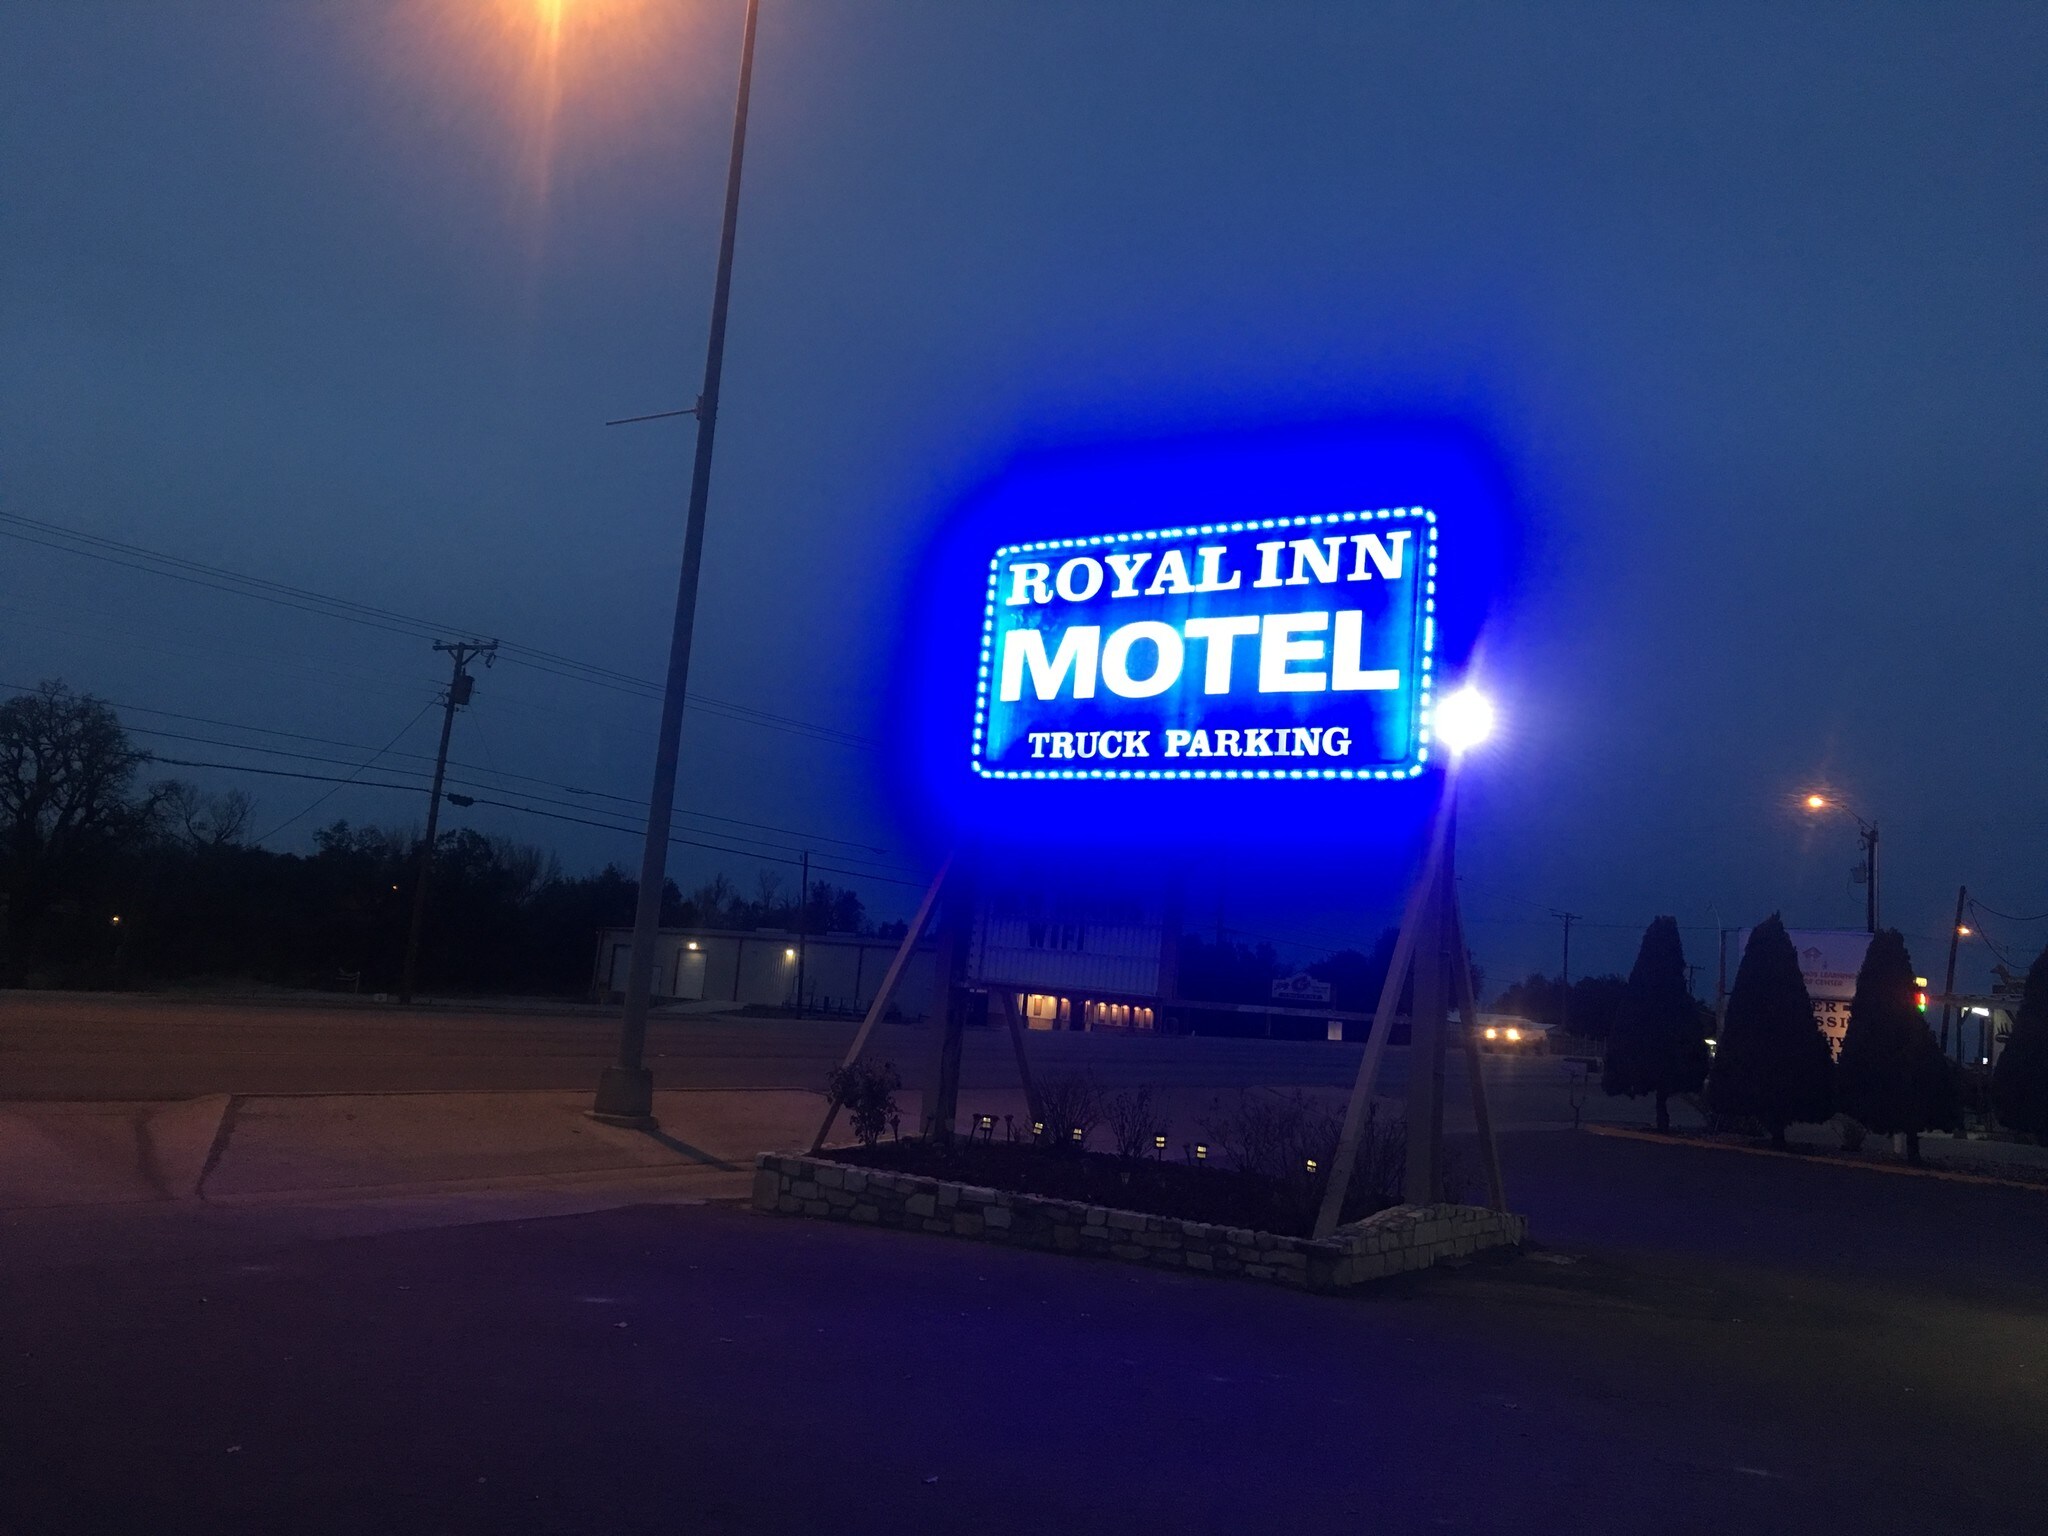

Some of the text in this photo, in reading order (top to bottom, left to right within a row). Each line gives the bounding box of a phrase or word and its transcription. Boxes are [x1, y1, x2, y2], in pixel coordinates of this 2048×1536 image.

[1005, 530, 1412, 606] ROYAL INN
[999, 609, 1400, 702] MOTEL
[1028, 726, 1352, 760] TRUCK PARKING
